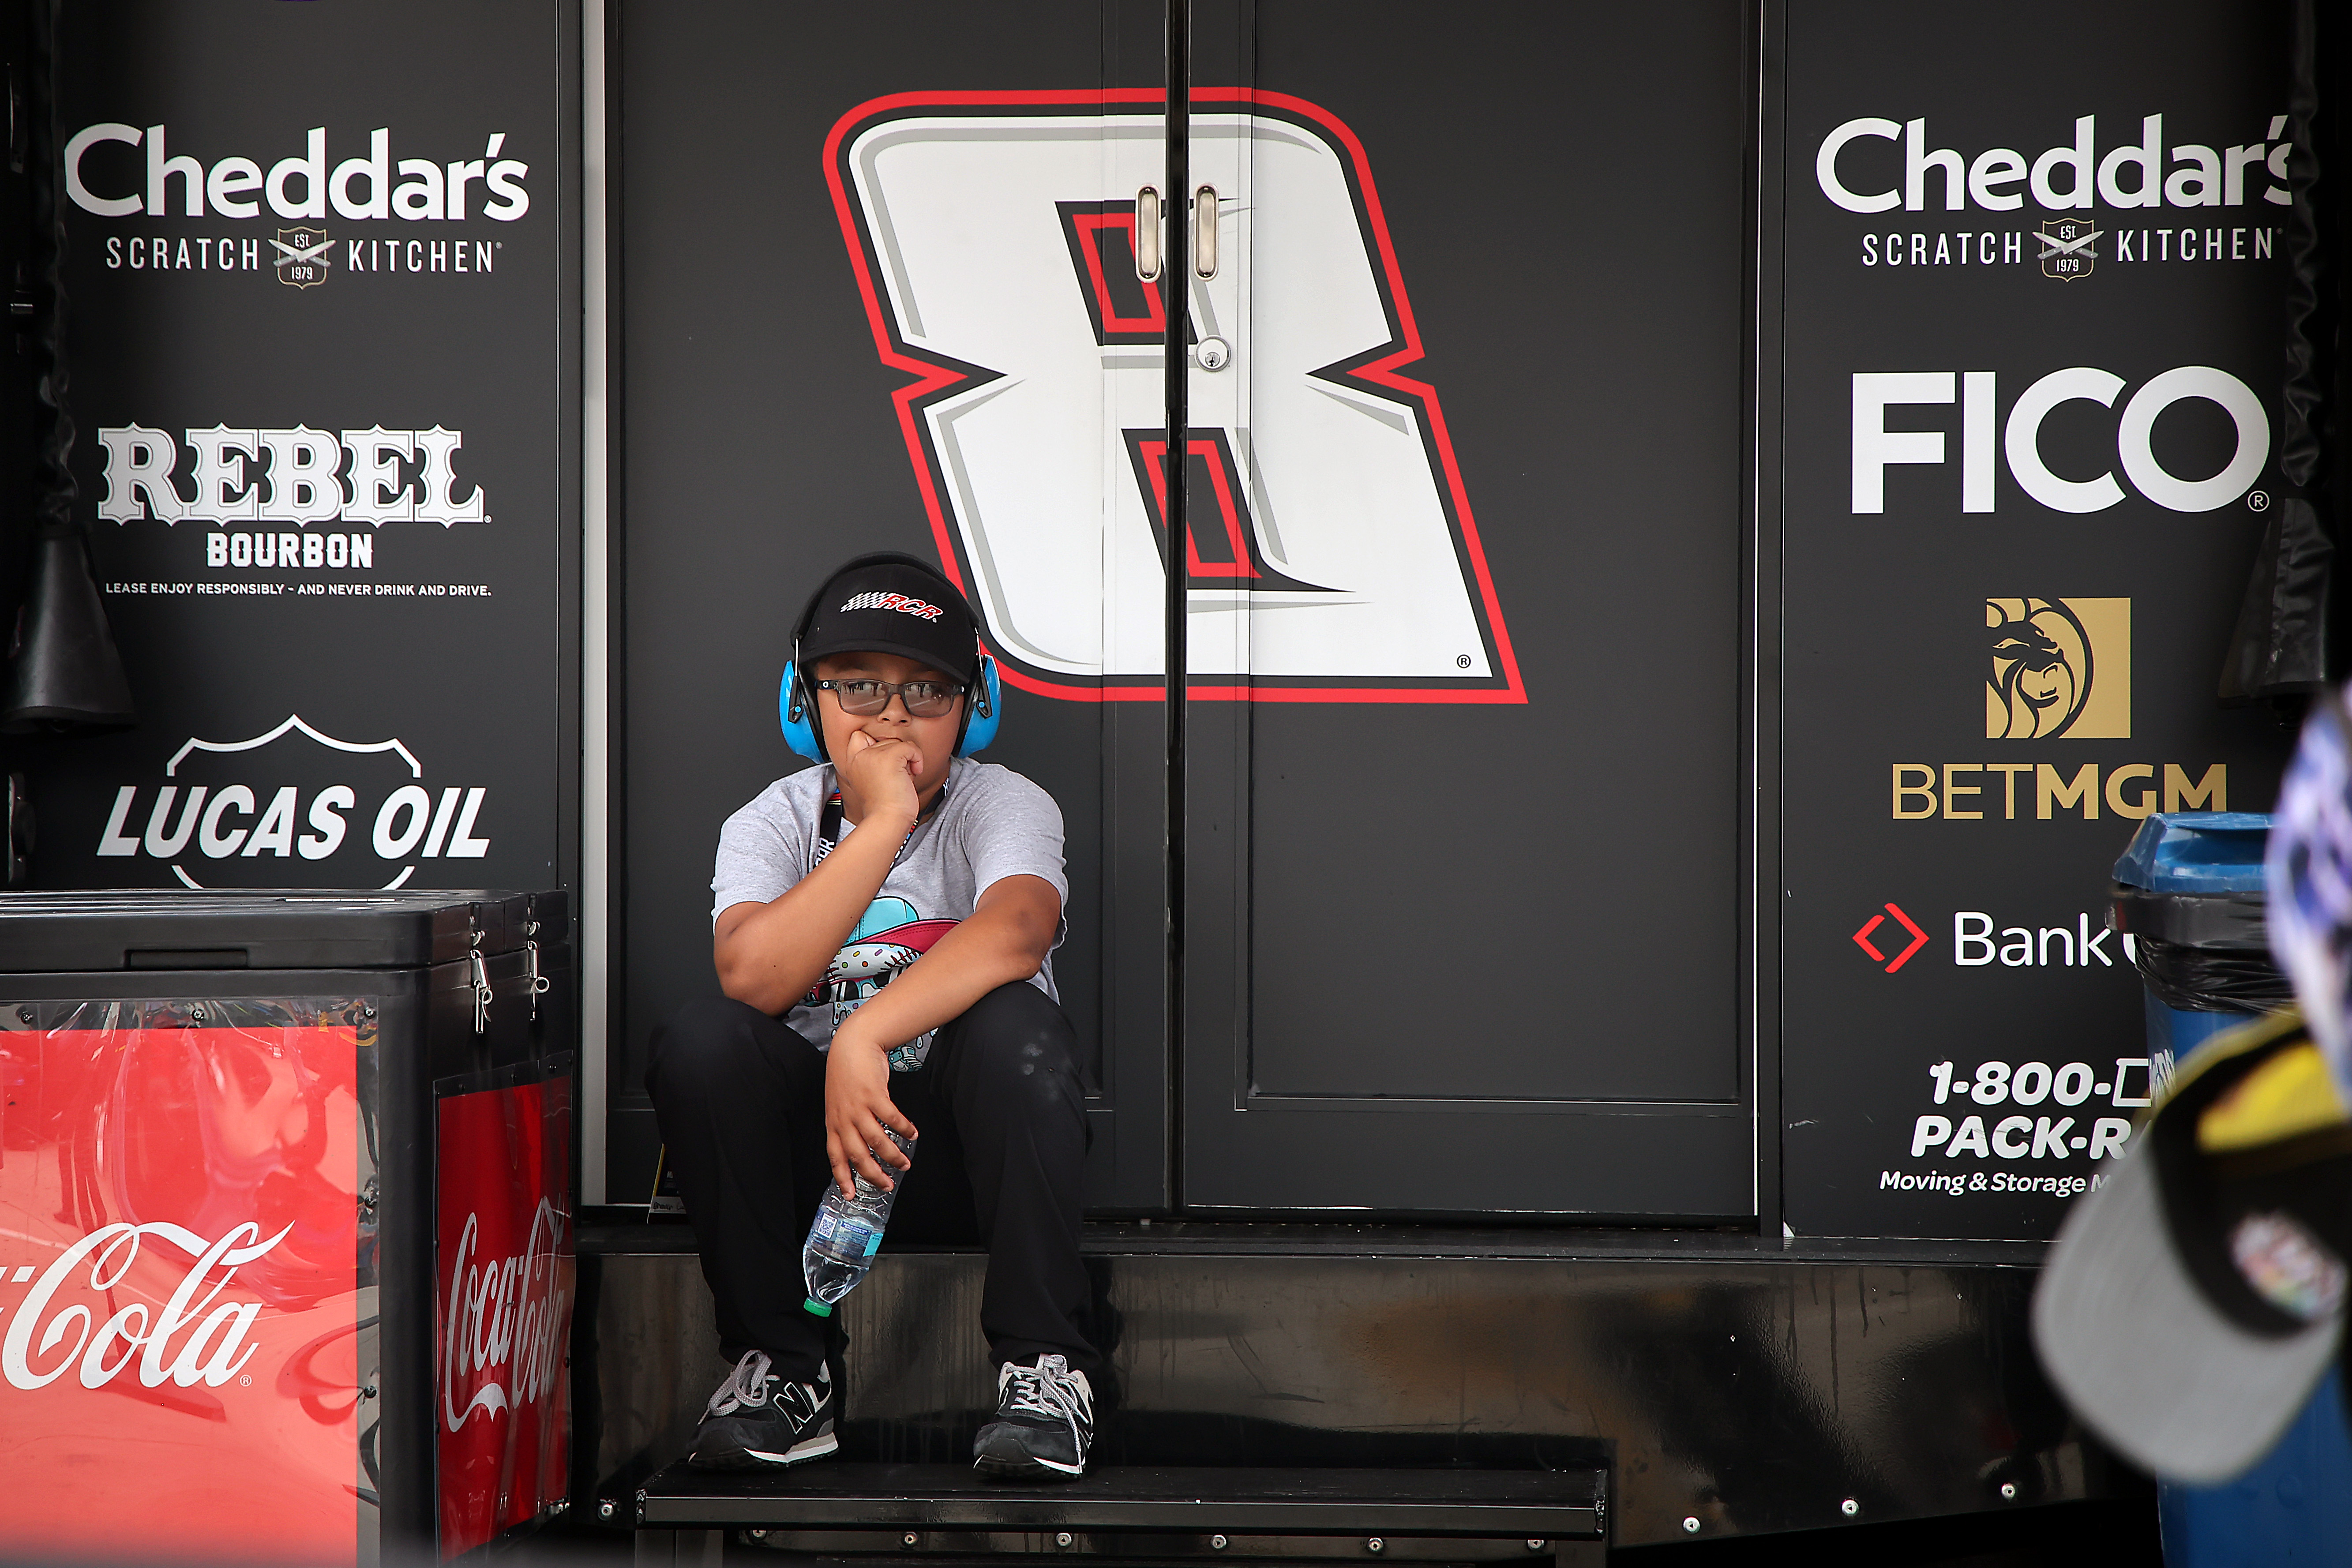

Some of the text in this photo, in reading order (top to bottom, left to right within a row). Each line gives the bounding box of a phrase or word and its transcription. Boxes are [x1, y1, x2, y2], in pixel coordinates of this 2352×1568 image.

[65, 123, 529, 221] Cheddar's
[106, 237, 493, 273] SCRATCH KITCHEN
[1862, 228, 2272, 266] SCRATCH KITCHEN
[2056, 259, 2079, 272] 1979
[291, 266, 314, 280] 1979
[822, 86, 1529, 705] 8
[1852, 366, 2270, 514] FICO
[98, 421, 484, 529] REBEL
[206, 533, 373, 568] BOURBON
[106, 583, 147, 594] LEASE
[151, 583, 193, 594] ENJOY
[197, 583, 285, 595] RESPONSIBLY
[297, 584, 325, 595] AND
[328, 584, 371, 596] NEVER
[375, 584, 415, 596] DRINK
[418, 584, 446, 596] AND
[449, 585, 491, 596] DRIVE.
[877, 593, 943, 620] RCR
[1892, 763, 2227, 820] BETMGM
[97, 784, 490, 860] LUCAS OIL
[1954, 912, 2136, 967] Bank
[1879, 1170, 1966, 1196] Moving
[1969, 1172, 1988, 1191] &
[1990, 1172, 2087, 1197] Storage
